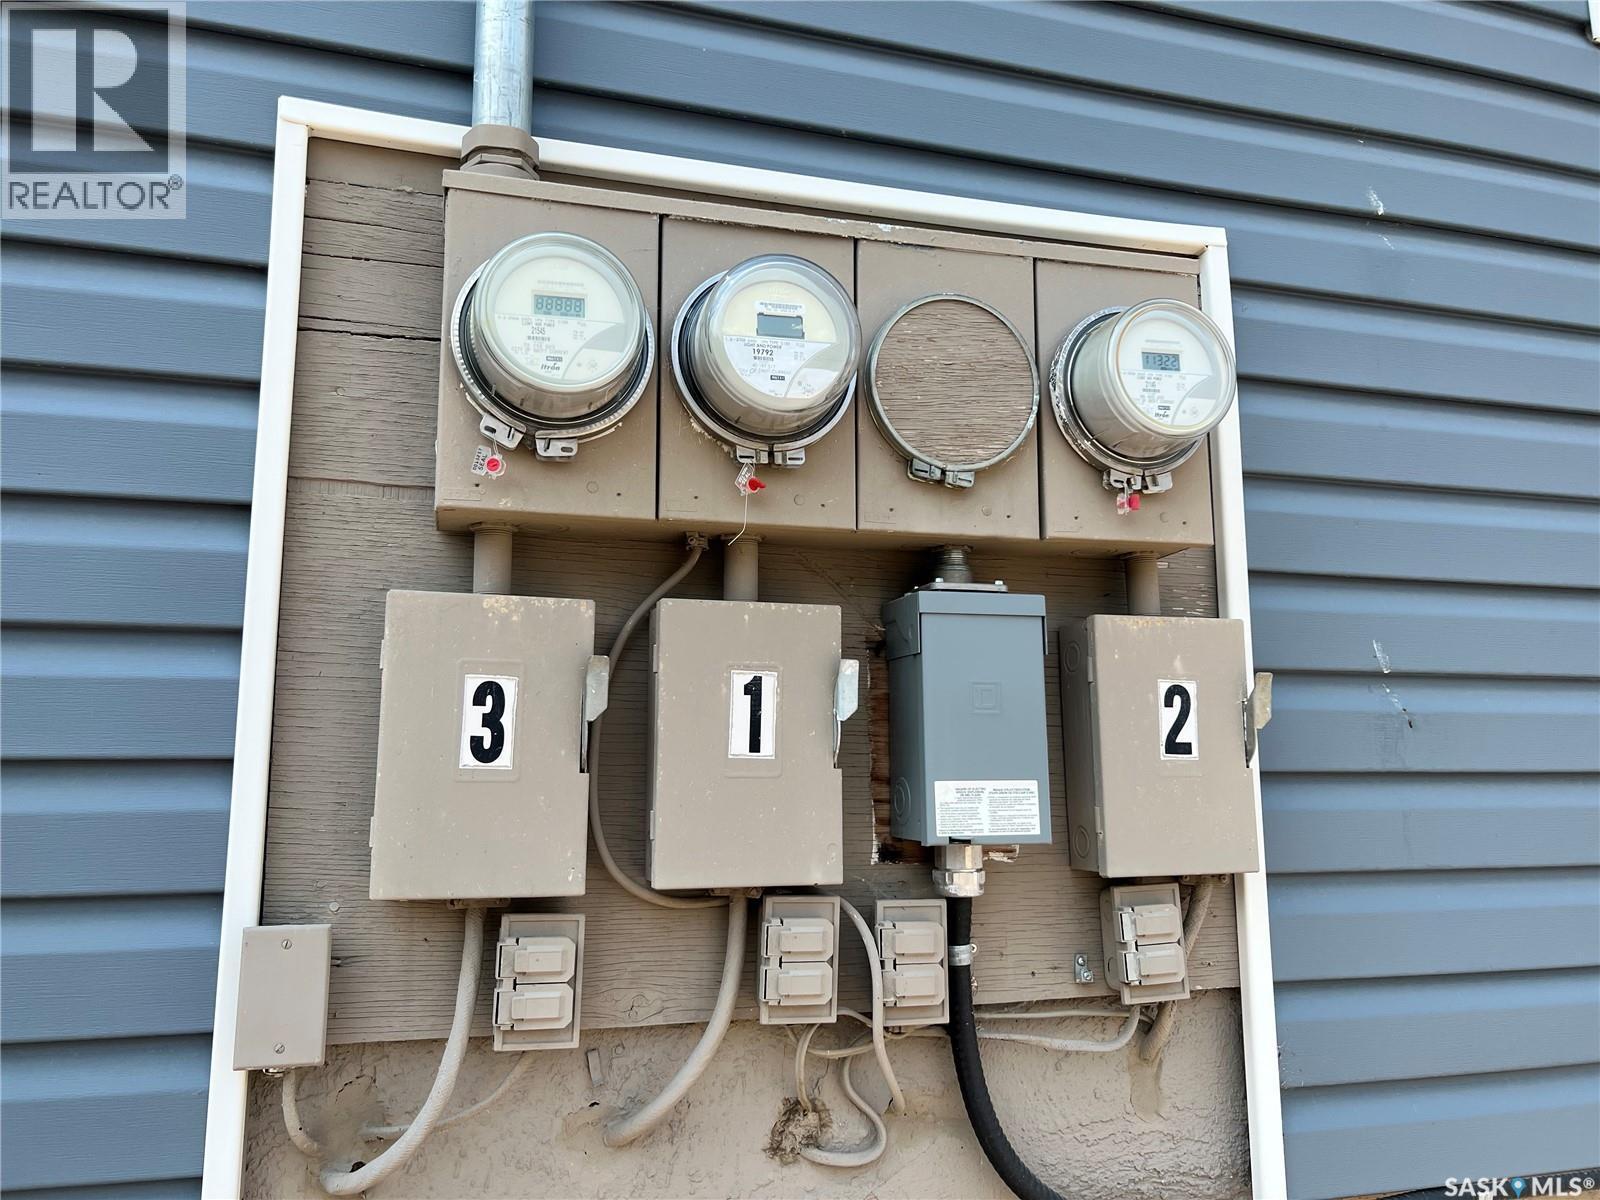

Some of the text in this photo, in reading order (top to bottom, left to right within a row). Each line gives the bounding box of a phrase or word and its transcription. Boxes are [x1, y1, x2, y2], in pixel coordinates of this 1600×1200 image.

[752, 348, 774, 356] 19792
[470, 680, 506, 764] 3
[743, 675, 763, 754] 1
[1163, 684, 1193, 755] 2
